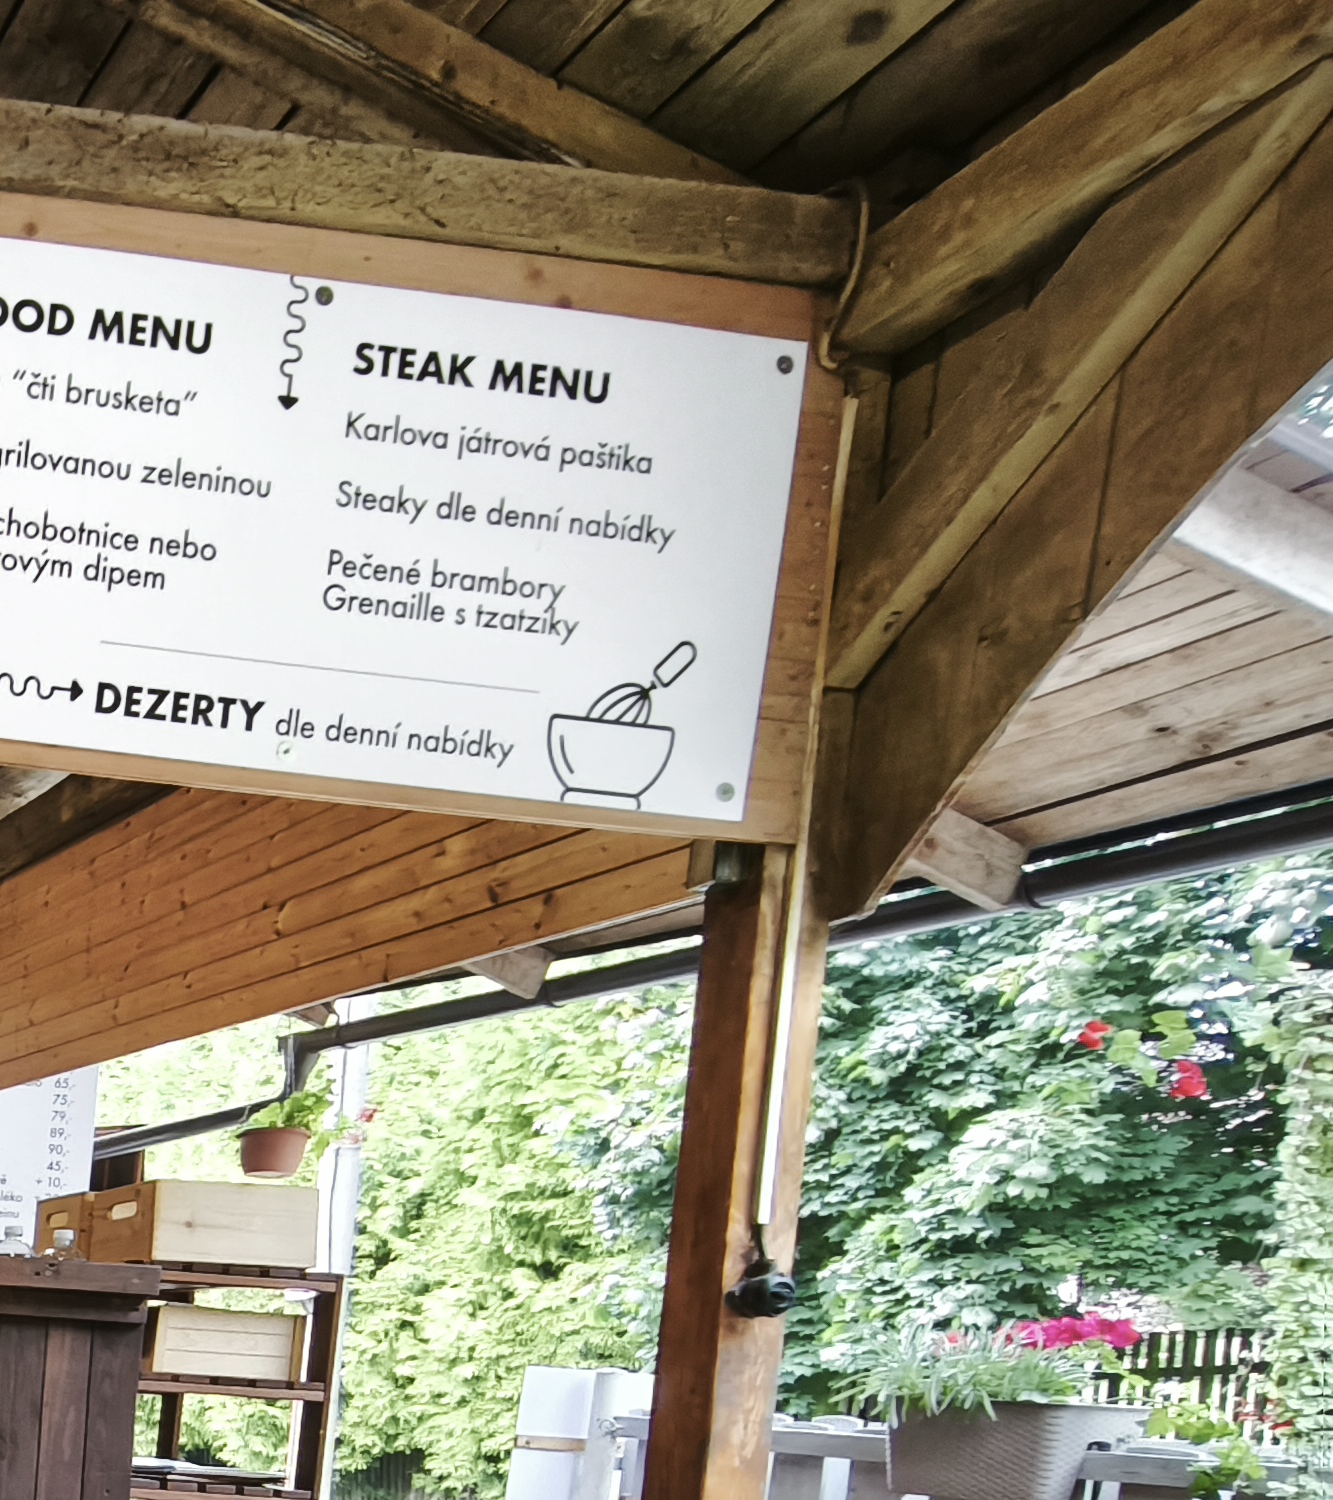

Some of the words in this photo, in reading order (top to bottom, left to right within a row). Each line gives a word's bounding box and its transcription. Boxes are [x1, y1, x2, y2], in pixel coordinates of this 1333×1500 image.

[88, 308, 213, 355] MENU
[353, 342, 477, 388] STEAK
[488, 359, 611, 404] MENU
[345, 411, 448, 449] Karlova
[457, 426, 550, 461] játrová
[559, 442, 652, 474] paštika
[140, 457, 271, 498] zeleninou
[149, 529, 217, 561] nebo
[336, 481, 428, 524] Steaky
[436, 491, 476, 522] dle
[486, 497, 563, 532] denní
[569, 510, 675, 554] nabídky
[83, 552, 165, 592] dipem
[327, 549, 421, 585] Pečené
[431, 558, 566, 613] brambory
[323, 584, 445, 622] Grenaille
[455, 608, 465, 625] s
[476, 604, 580, 646] tzatziky
[94, 681, 266, 732] DEZERTY
[276, 708, 315, 739] dle
[325, 713, 402, 748] denní
[407, 725, 514, 768] nabídky
